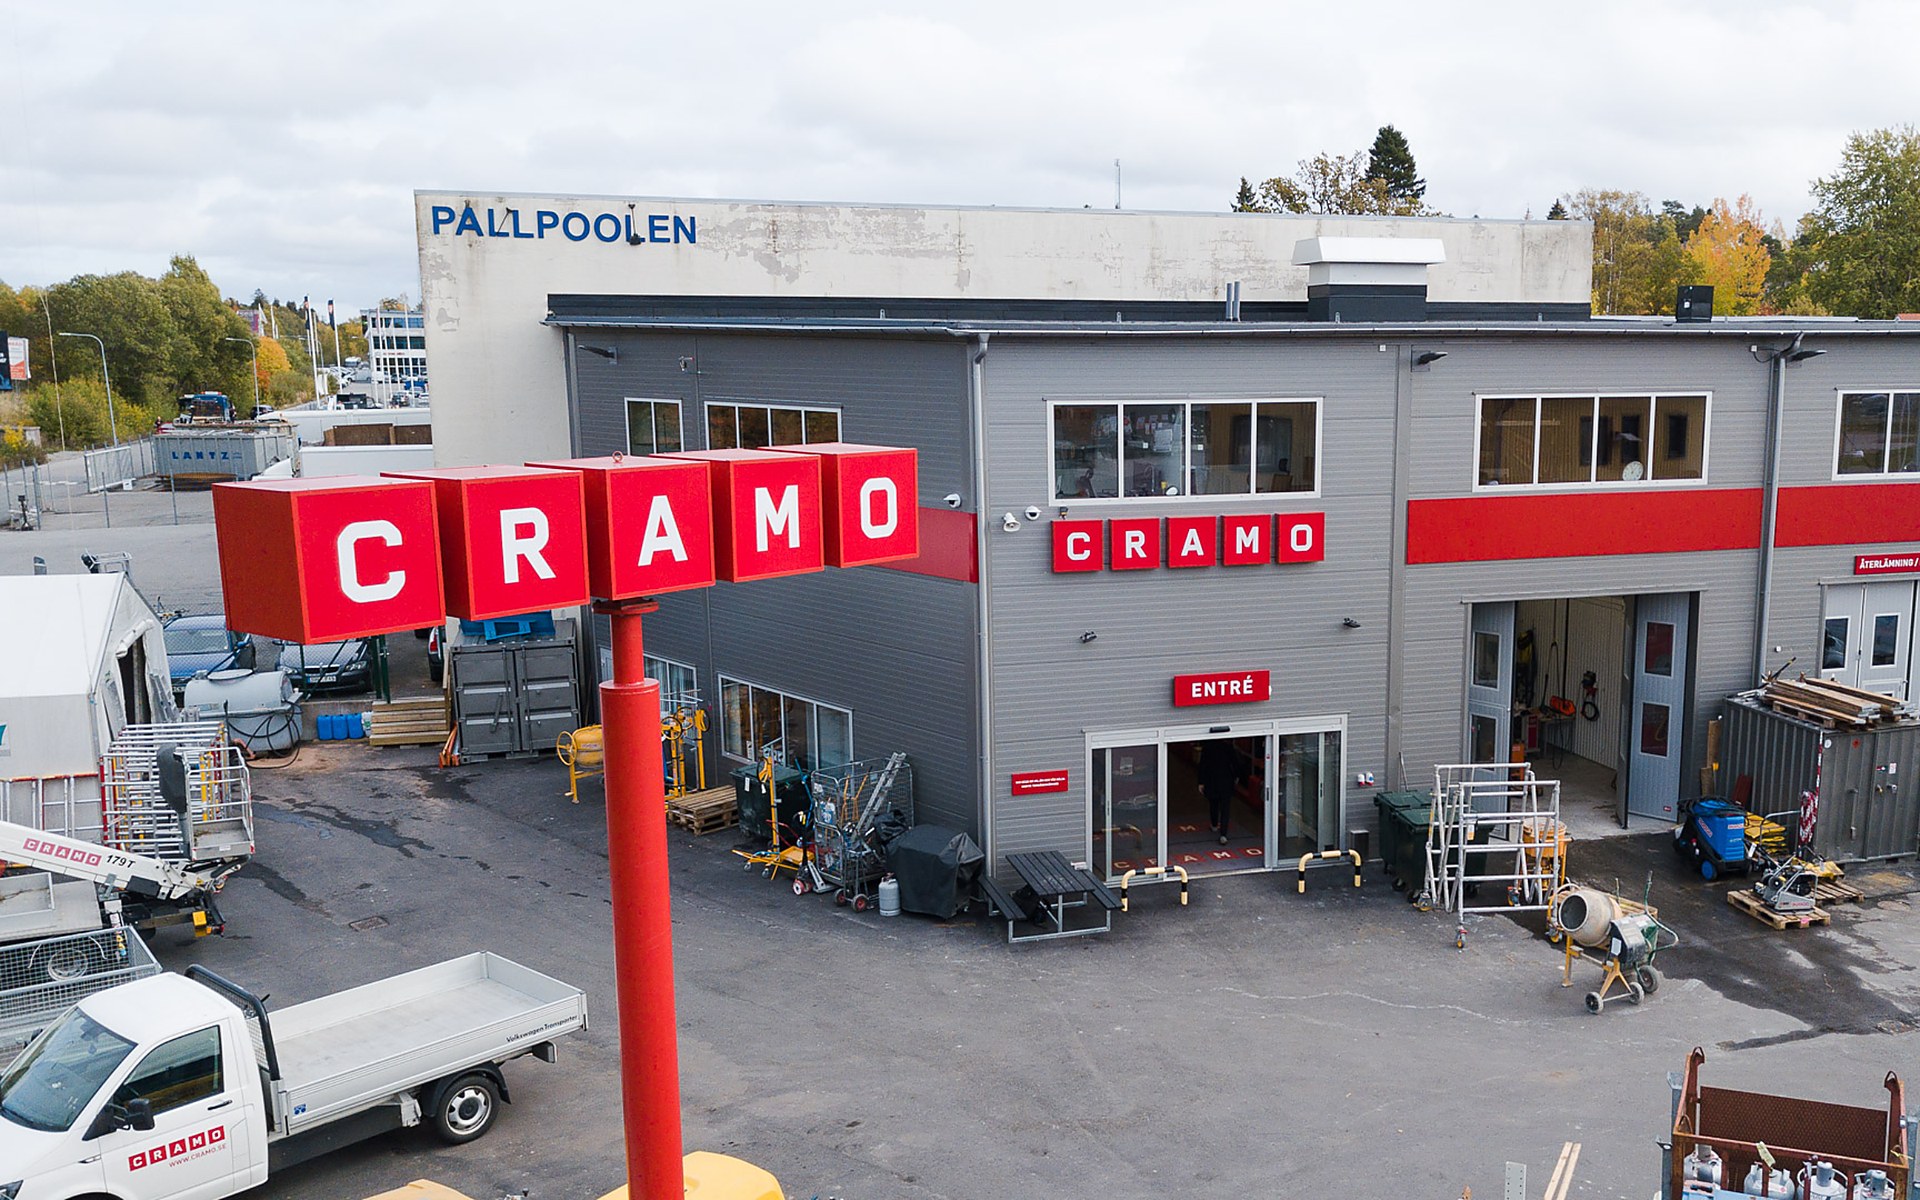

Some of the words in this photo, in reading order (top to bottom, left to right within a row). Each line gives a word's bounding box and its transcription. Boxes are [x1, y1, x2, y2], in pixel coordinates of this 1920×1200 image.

[431, 205, 697, 245] PALLPOOLEN
[171, 451, 229, 460] LANTZ
[336, 476, 899, 603] CRAMO
[1066, 523, 1313, 561] CRAMO
[1859, 557, 1914, 569] ÅTERLÄMNING
[1191, 674, 1254, 698] ENTRÉ
[26, 840, 99, 864] CRAMO
[106, 853, 136, 868] 179T
[505, 1026, 544, 1043] Volkswagen
[544, 1014, 578, 1031] Transporter
[132, 1129, 222, 1168] CRAMO
[168, 1143, 227, 1168] WWW.CRAMO.SE
